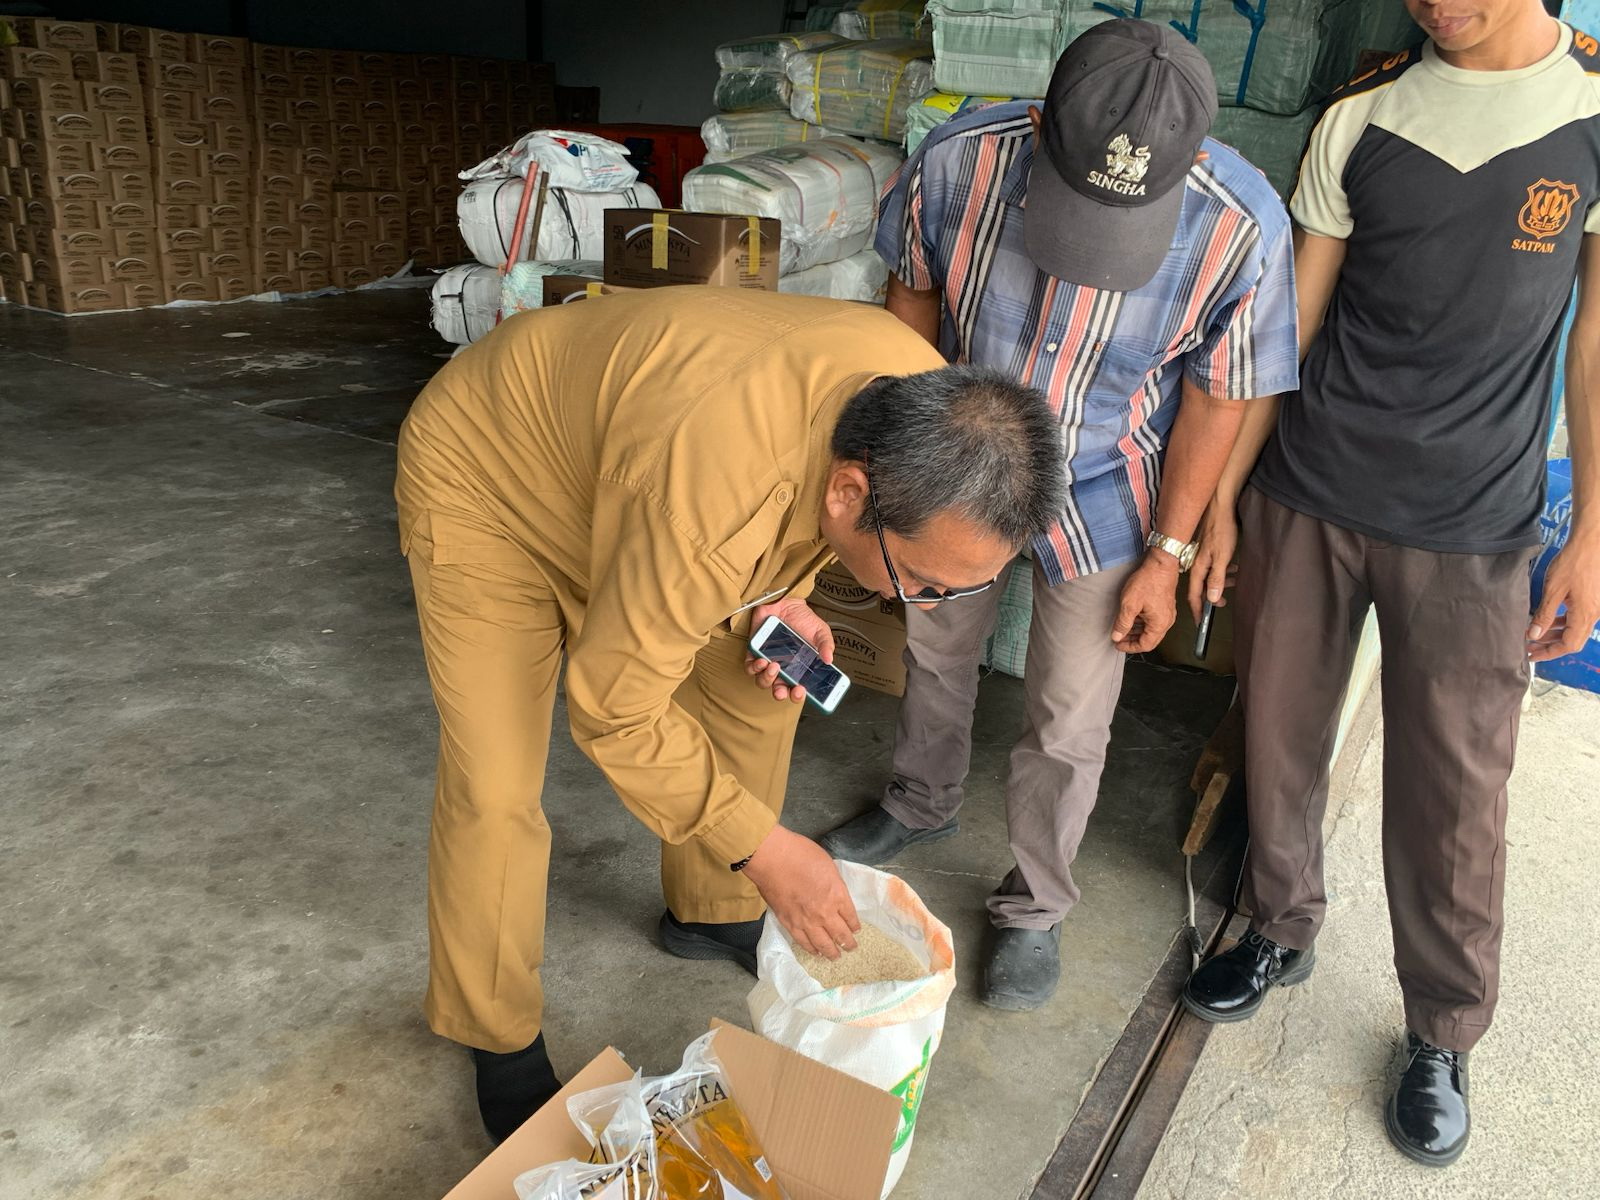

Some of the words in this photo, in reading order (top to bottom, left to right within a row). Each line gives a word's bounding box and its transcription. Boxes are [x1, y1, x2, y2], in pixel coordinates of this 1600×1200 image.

[1087, 170, 1146, 196] SINGHA
[634, 238, 691, 258] MINKITA
[1511, 238, 1555, 254] SATPAM
[834, 635, 877, 661] YAKITA
